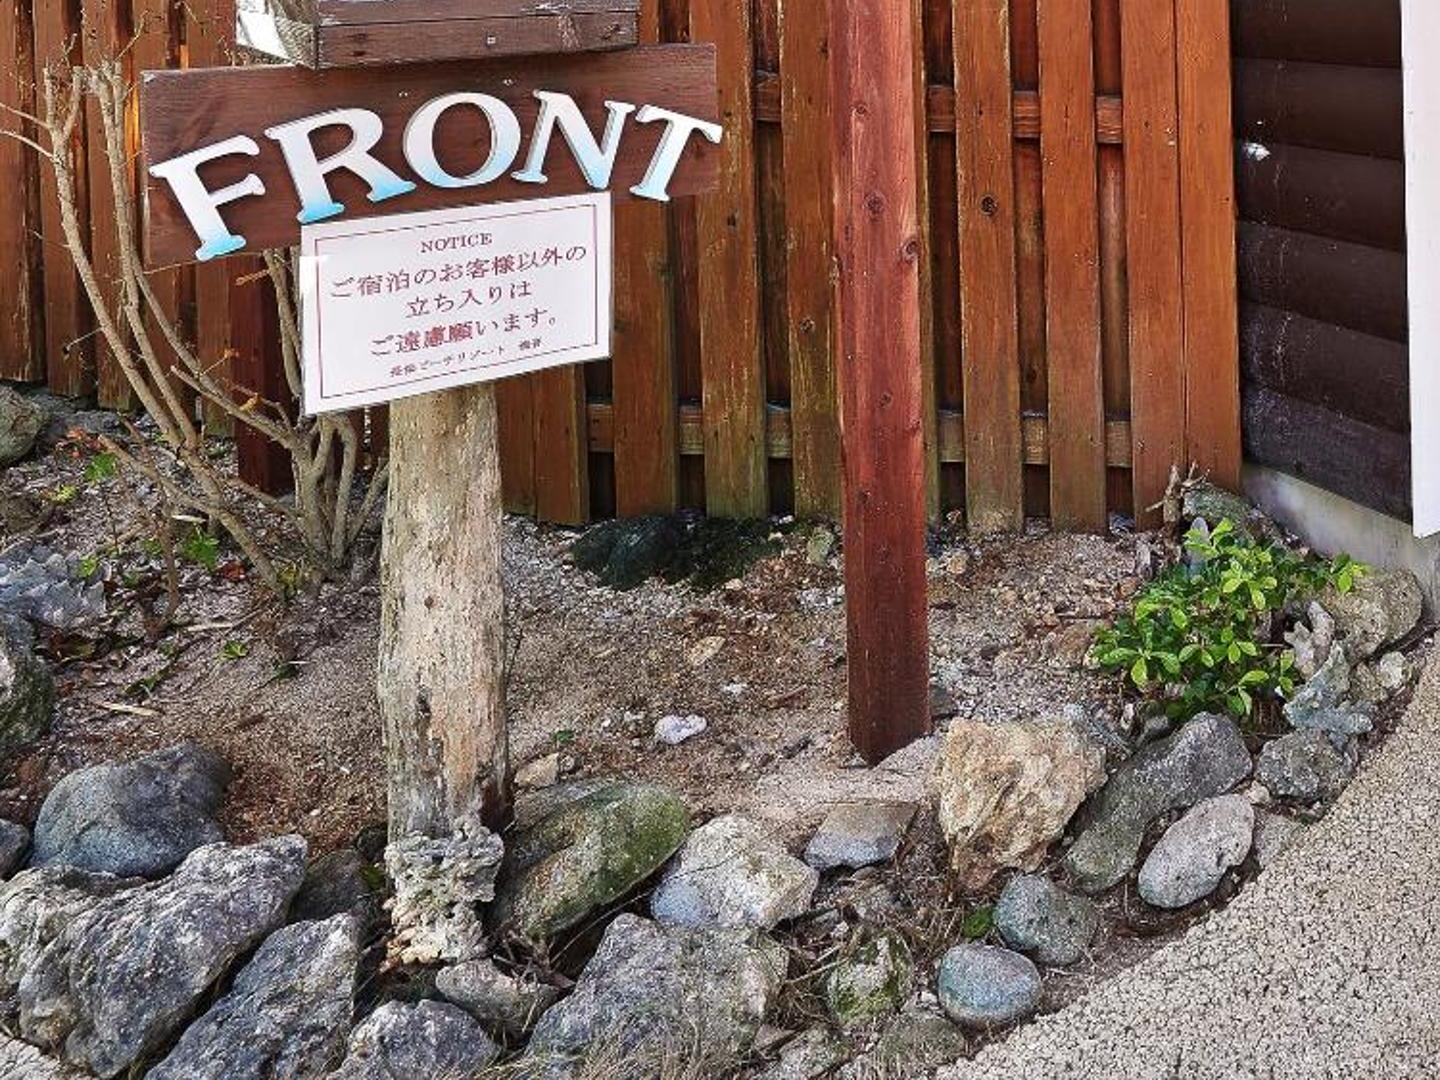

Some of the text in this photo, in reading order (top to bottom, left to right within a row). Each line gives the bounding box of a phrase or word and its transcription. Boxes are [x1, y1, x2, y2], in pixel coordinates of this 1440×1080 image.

[148, 88, 724, 262] FRONT
[420, 232, 493, 254] NOTICE
[331, 245, 588, 299] ご宿泊のお客様以外の
[405, 280, 533, 319] 立ち入りは
[371, 307, 556, 357] ご遠慮願います。
